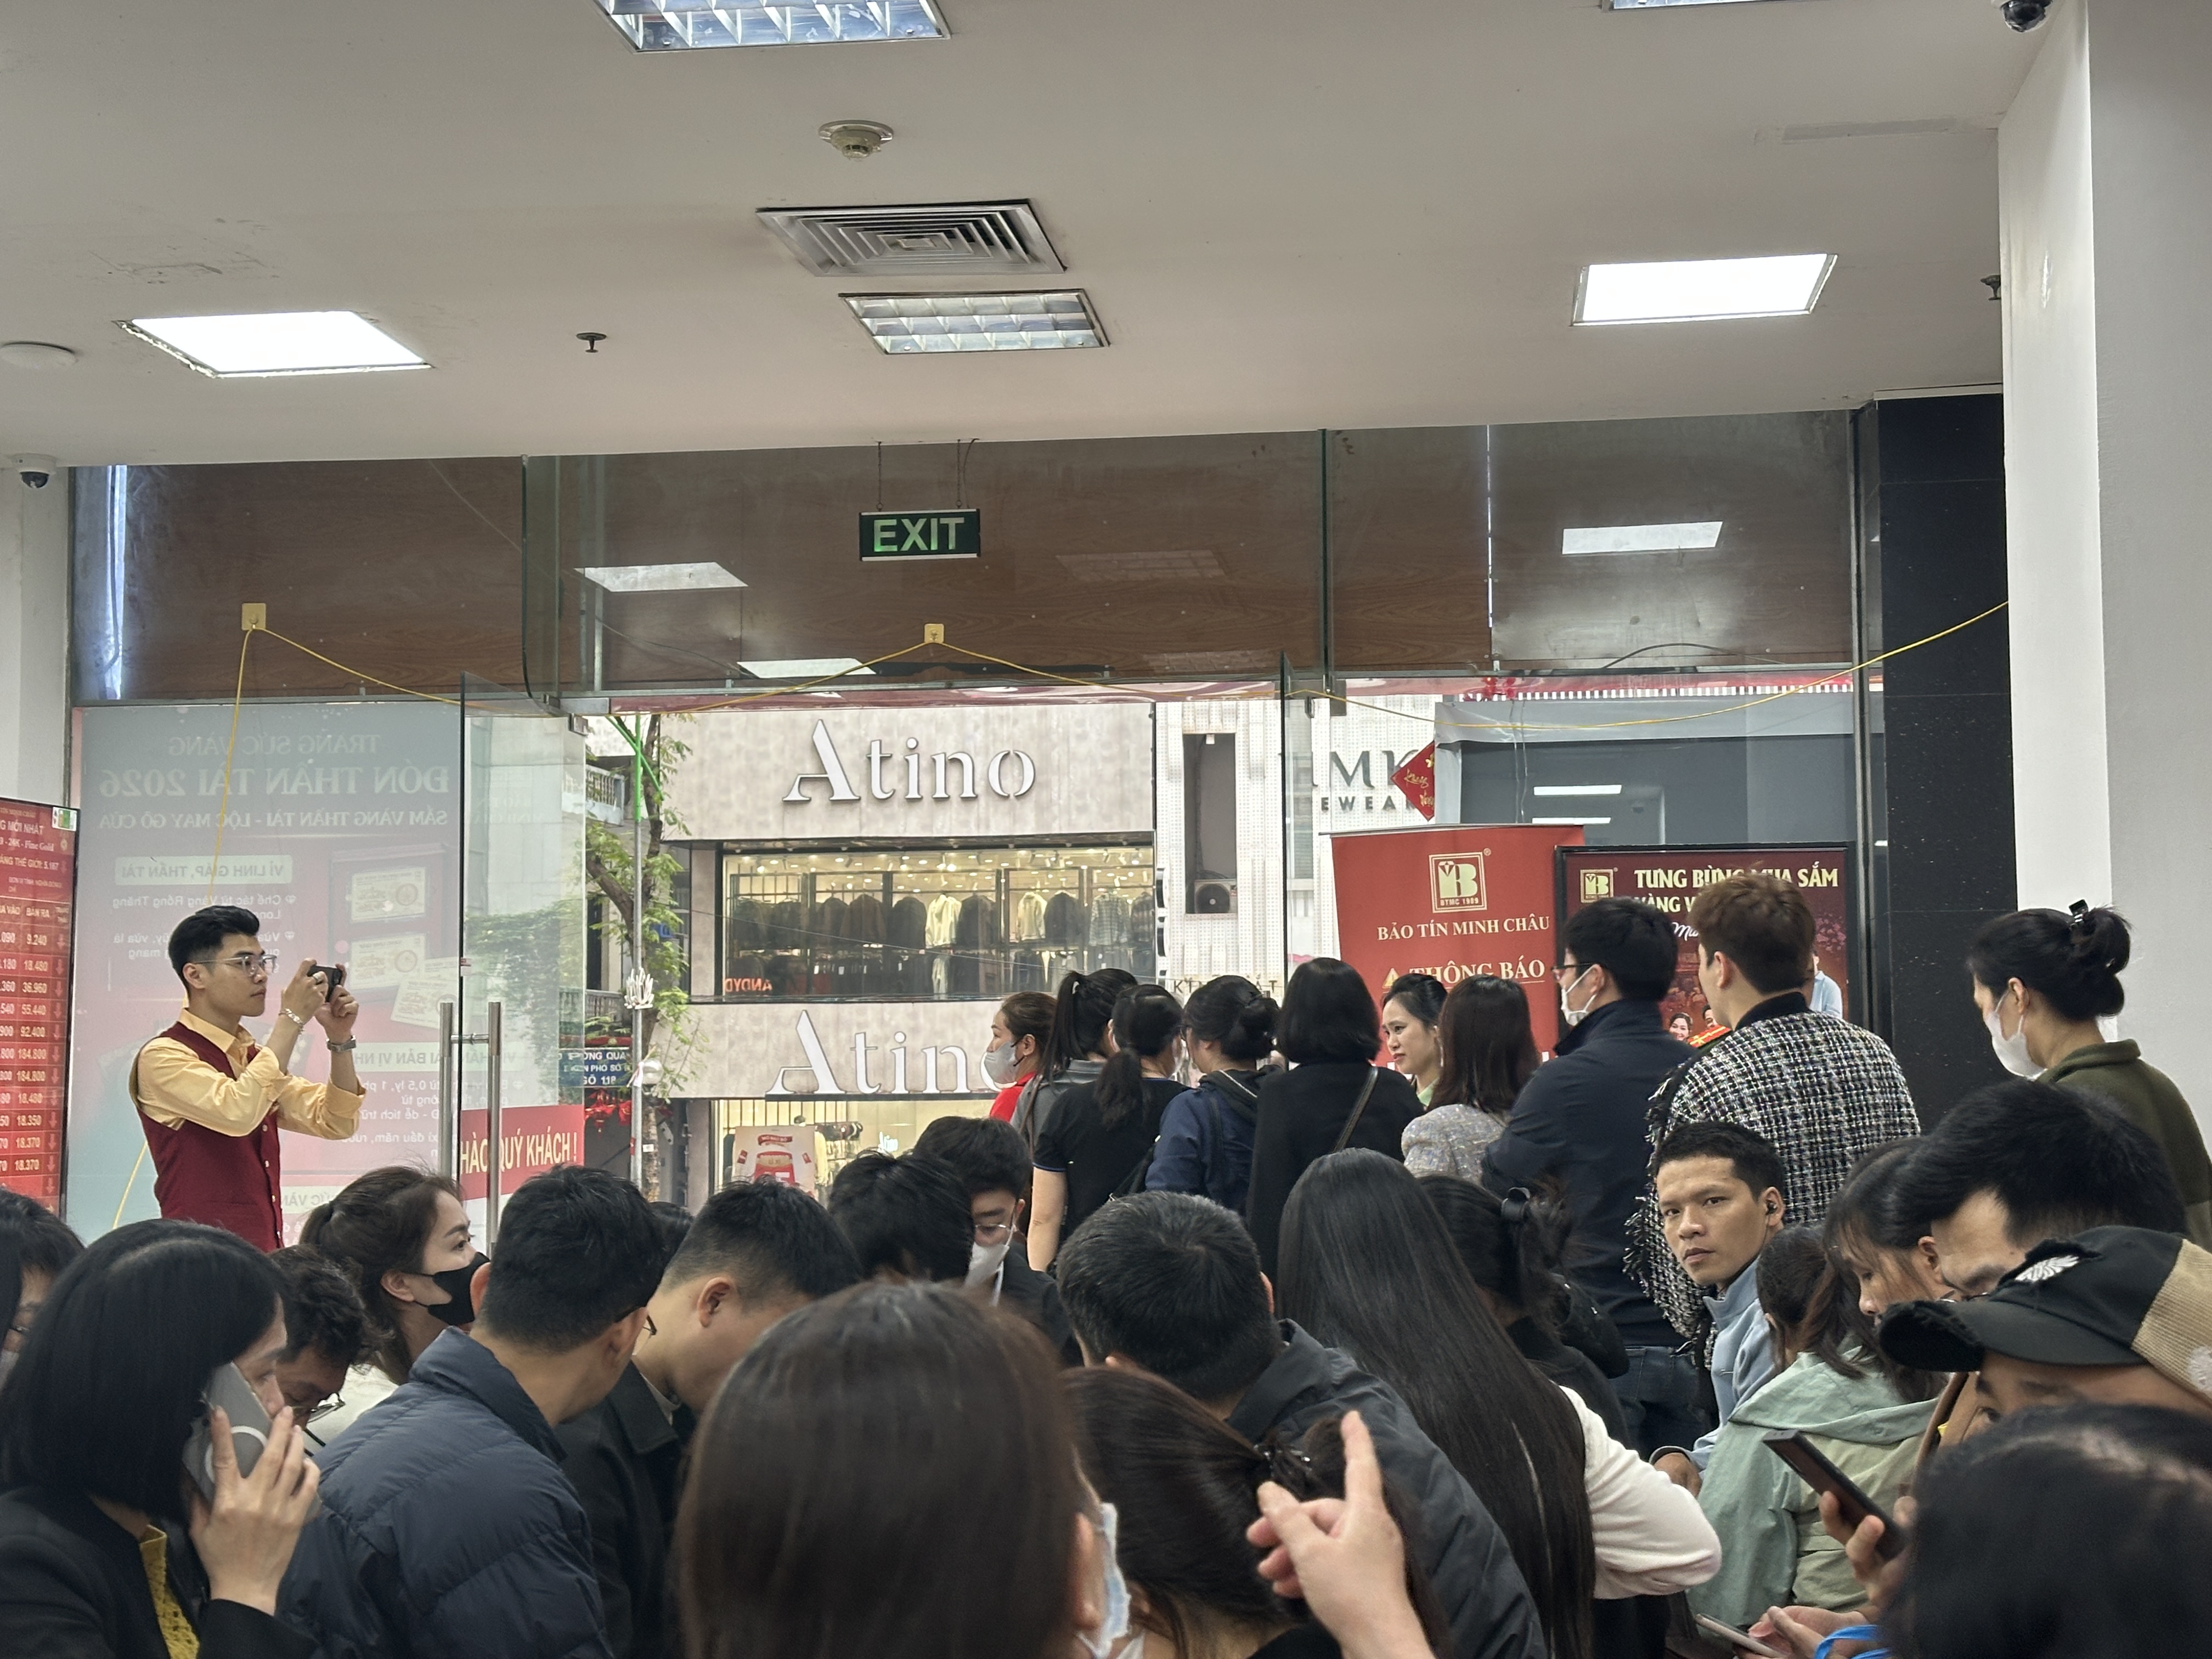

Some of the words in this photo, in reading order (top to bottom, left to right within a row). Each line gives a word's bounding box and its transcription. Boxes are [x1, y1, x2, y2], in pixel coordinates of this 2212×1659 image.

[873, 517, 964, 552] EXIT
[782, 719, 1035, 802] Atino
[1797, 861, 1838, 888] SẮM
[1377, 922, 1414, 941] BẢO
[1417, 919, 1449, 938] TÍN
[1453, 919, 1499, 936] MINH
[1503, 913, 1550, 932] CHÂU
[27, 934, 47, 946] 9.240
[1498, 955, 1545, 980] BÁO
[22, 982, 48, 994] 36.960
[21, 1004, 46, 1015] 55.440
[20, 1026, 46, 1038] 92.400
[18, 1048, 47, 1060] 184.800
[16, 1070, 46, 1082] 184.800
[583, 1074, 597, 1085] GÕ
[18, 1092, 44, 1104] 18.480
[16, 1115, 42, 1127] 18.350
[15, 1137, 41, 1150] 18.370
[526, 1126, 571, 1167] KHÁCH
[14, 1158, 40, 1172] 18.370
